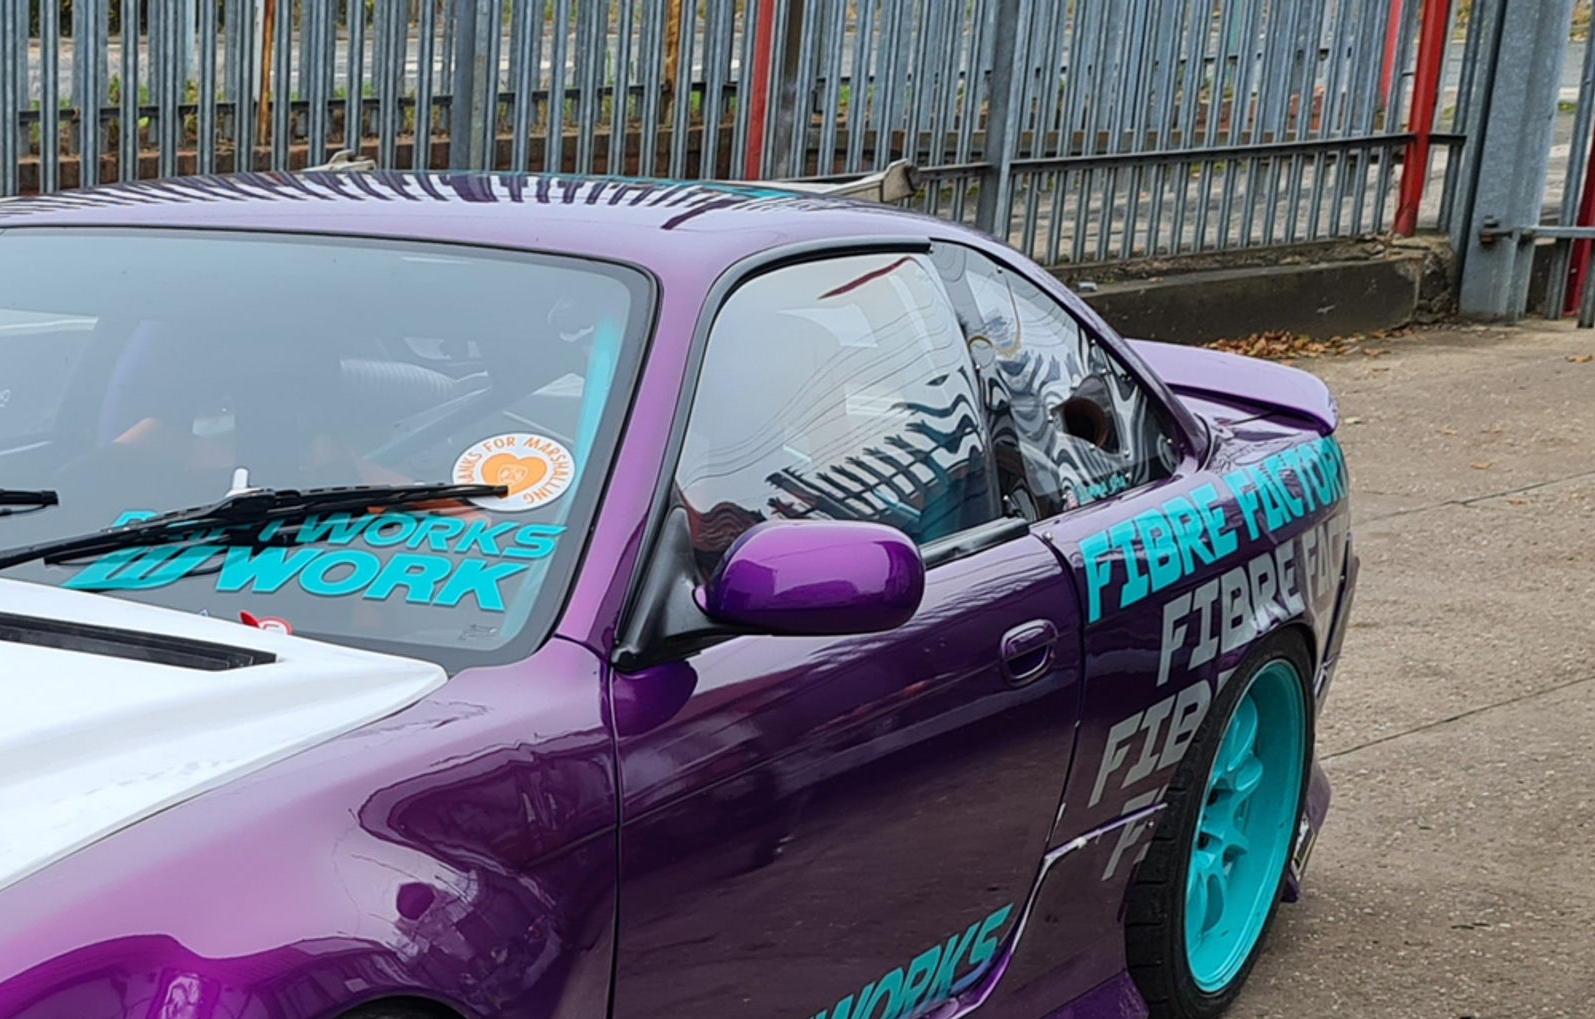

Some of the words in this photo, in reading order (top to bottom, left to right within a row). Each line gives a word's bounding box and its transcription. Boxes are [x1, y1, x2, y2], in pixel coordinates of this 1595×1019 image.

[483, 437, 516, 453] FOR
[522, 437, 570, 504] MARSHALLING
[216, 546, 531, 612] WORK
[1078, 484, 1241, 624] FIBRE
[1157, 542, 1305, 687] FIBRE
